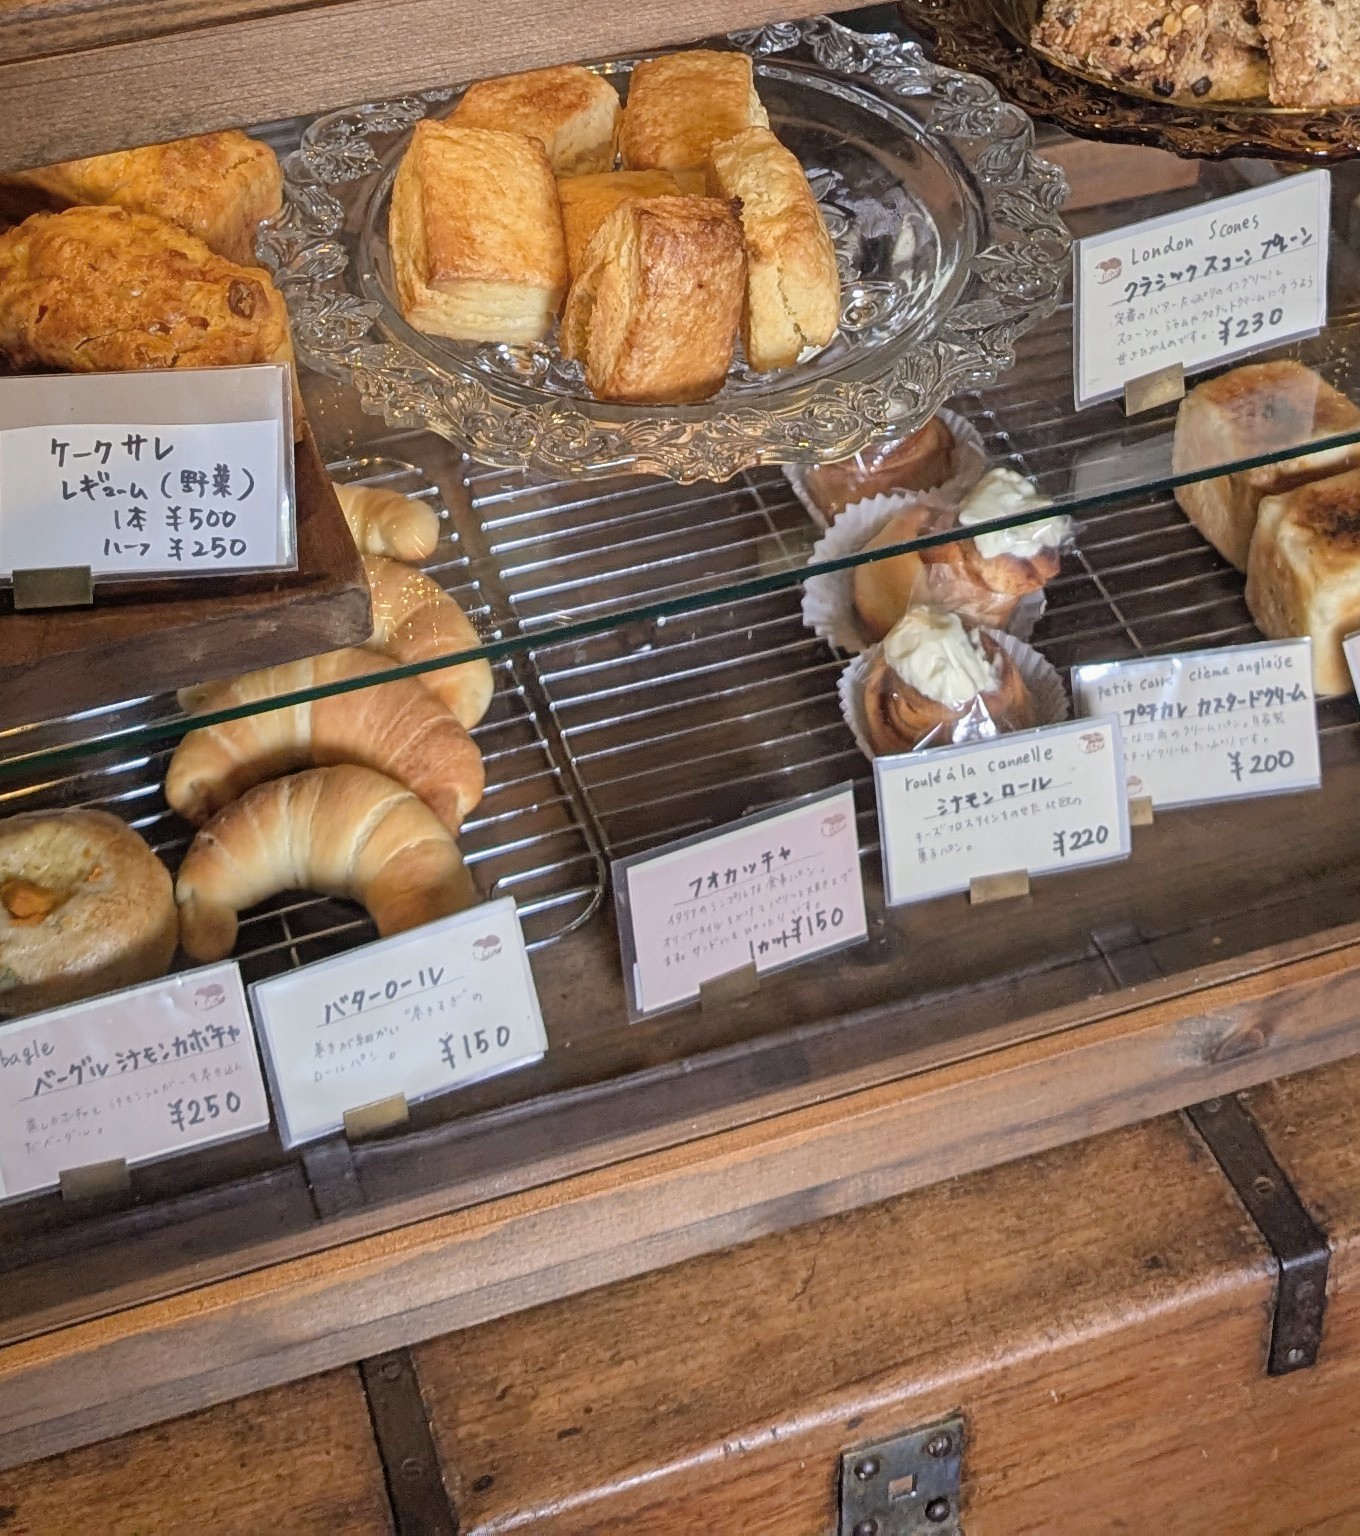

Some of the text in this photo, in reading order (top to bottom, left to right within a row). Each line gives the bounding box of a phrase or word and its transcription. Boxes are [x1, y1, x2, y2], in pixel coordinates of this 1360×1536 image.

[1131, 214, 1260, 265] London Scones
[1218, 307, 1284, 346] ¥230
[50, 433, 175, 468] ケークサレ
[113, 505, 238, 533] 1本 ¥500
[102, 537, 247, 562] ハーフ ¥250
[1226, 749, 1295, 782] ¥200
[1051, 824, 1110, 858] ¥220
[788, 906, 845, 944] ¥150
[323, 965, 446, 1025] バターロール
[438, 1024, 512, 1071] ¥150
[32, 1055, 110, 1098] ベーグル
[167, 1090, 242, 1133] ¥250
